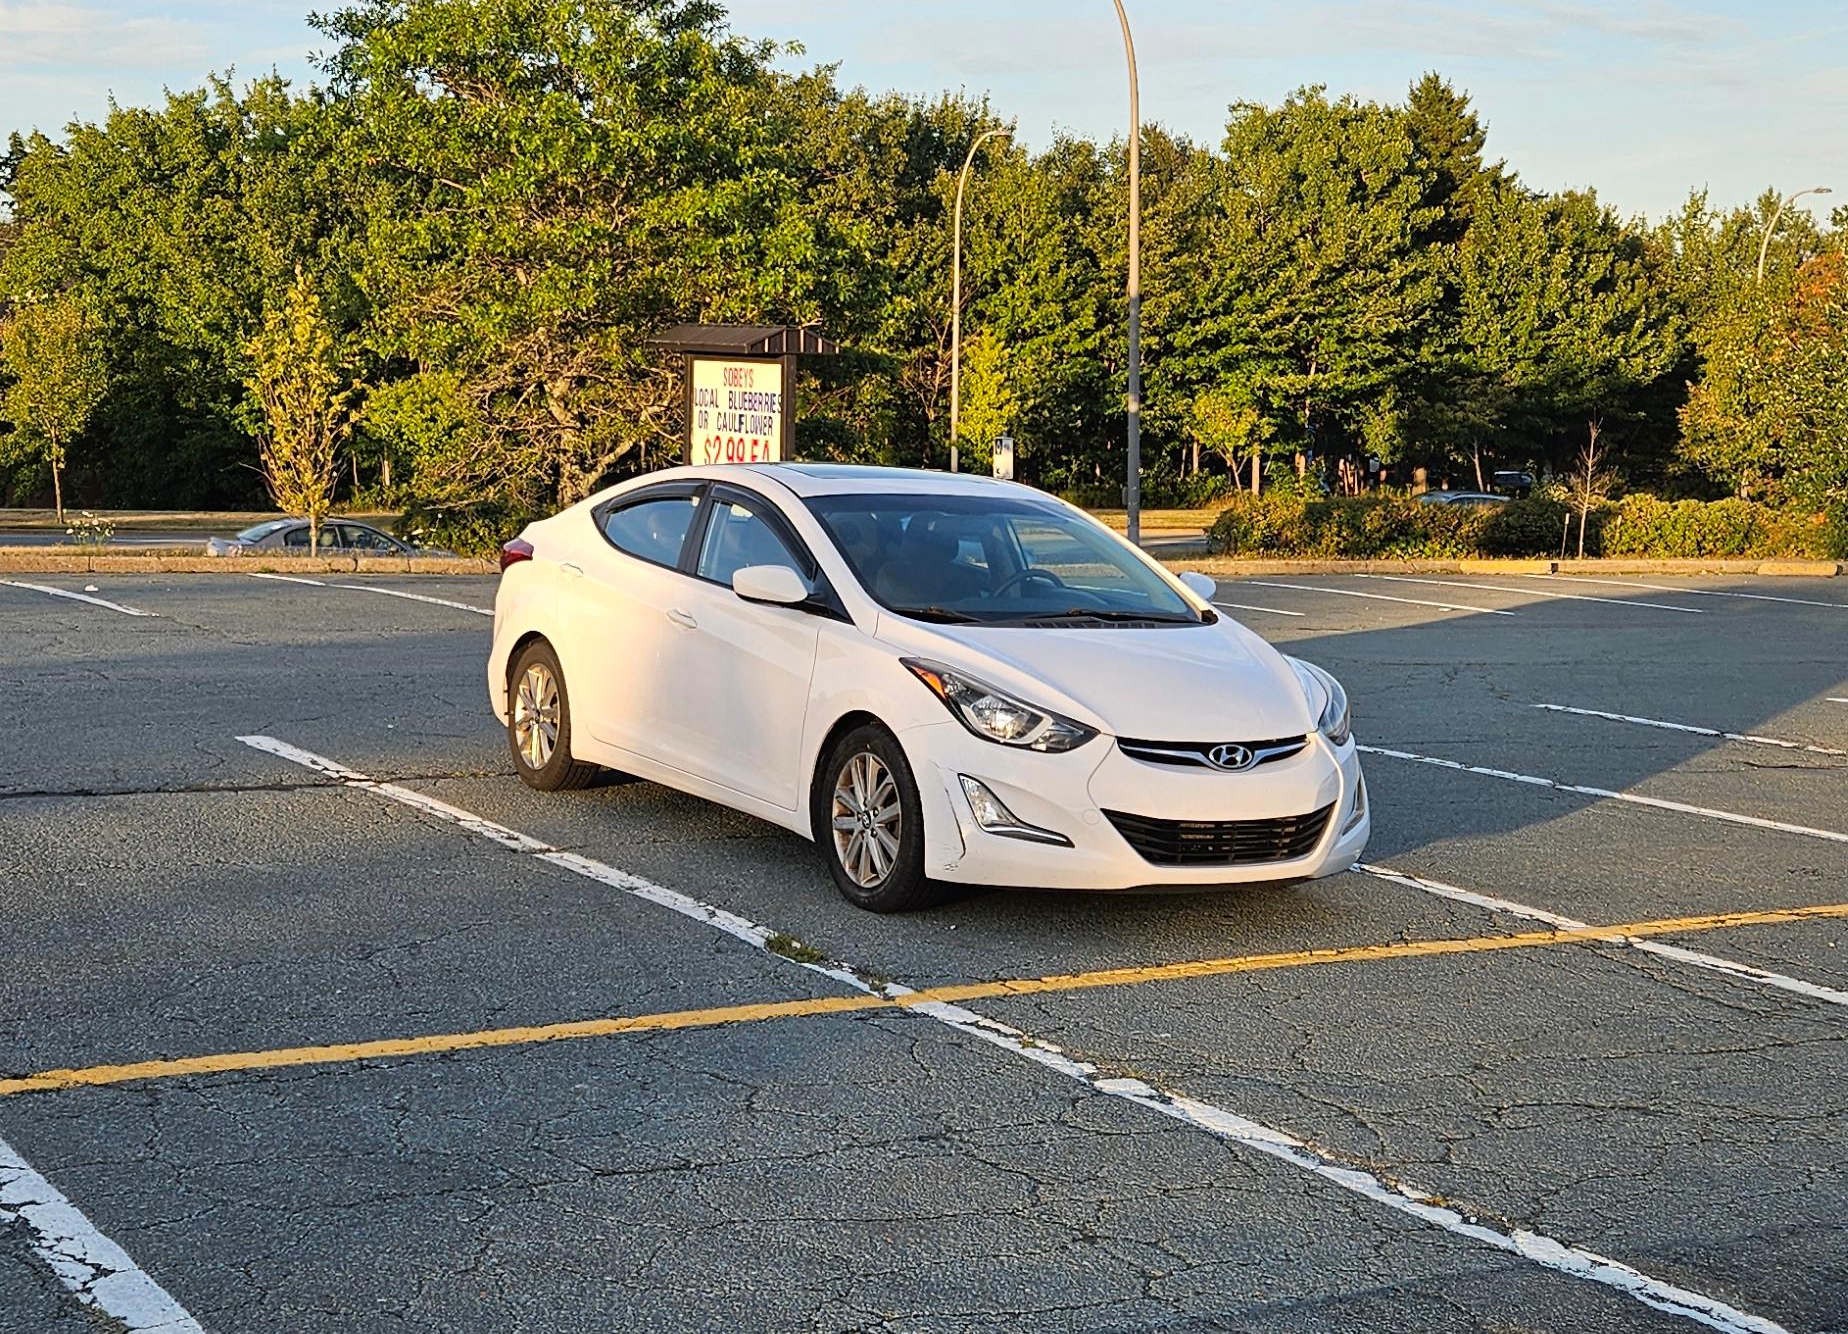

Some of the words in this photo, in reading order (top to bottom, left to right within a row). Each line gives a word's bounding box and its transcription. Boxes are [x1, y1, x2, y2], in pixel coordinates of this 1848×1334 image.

[723, 367, 754, 388] SOBEYS
[695, 388, 719, 408] LOCAL
[729, 390, 781, 413] BLUEBERRIES
[698, 410, 709, 430] OR
